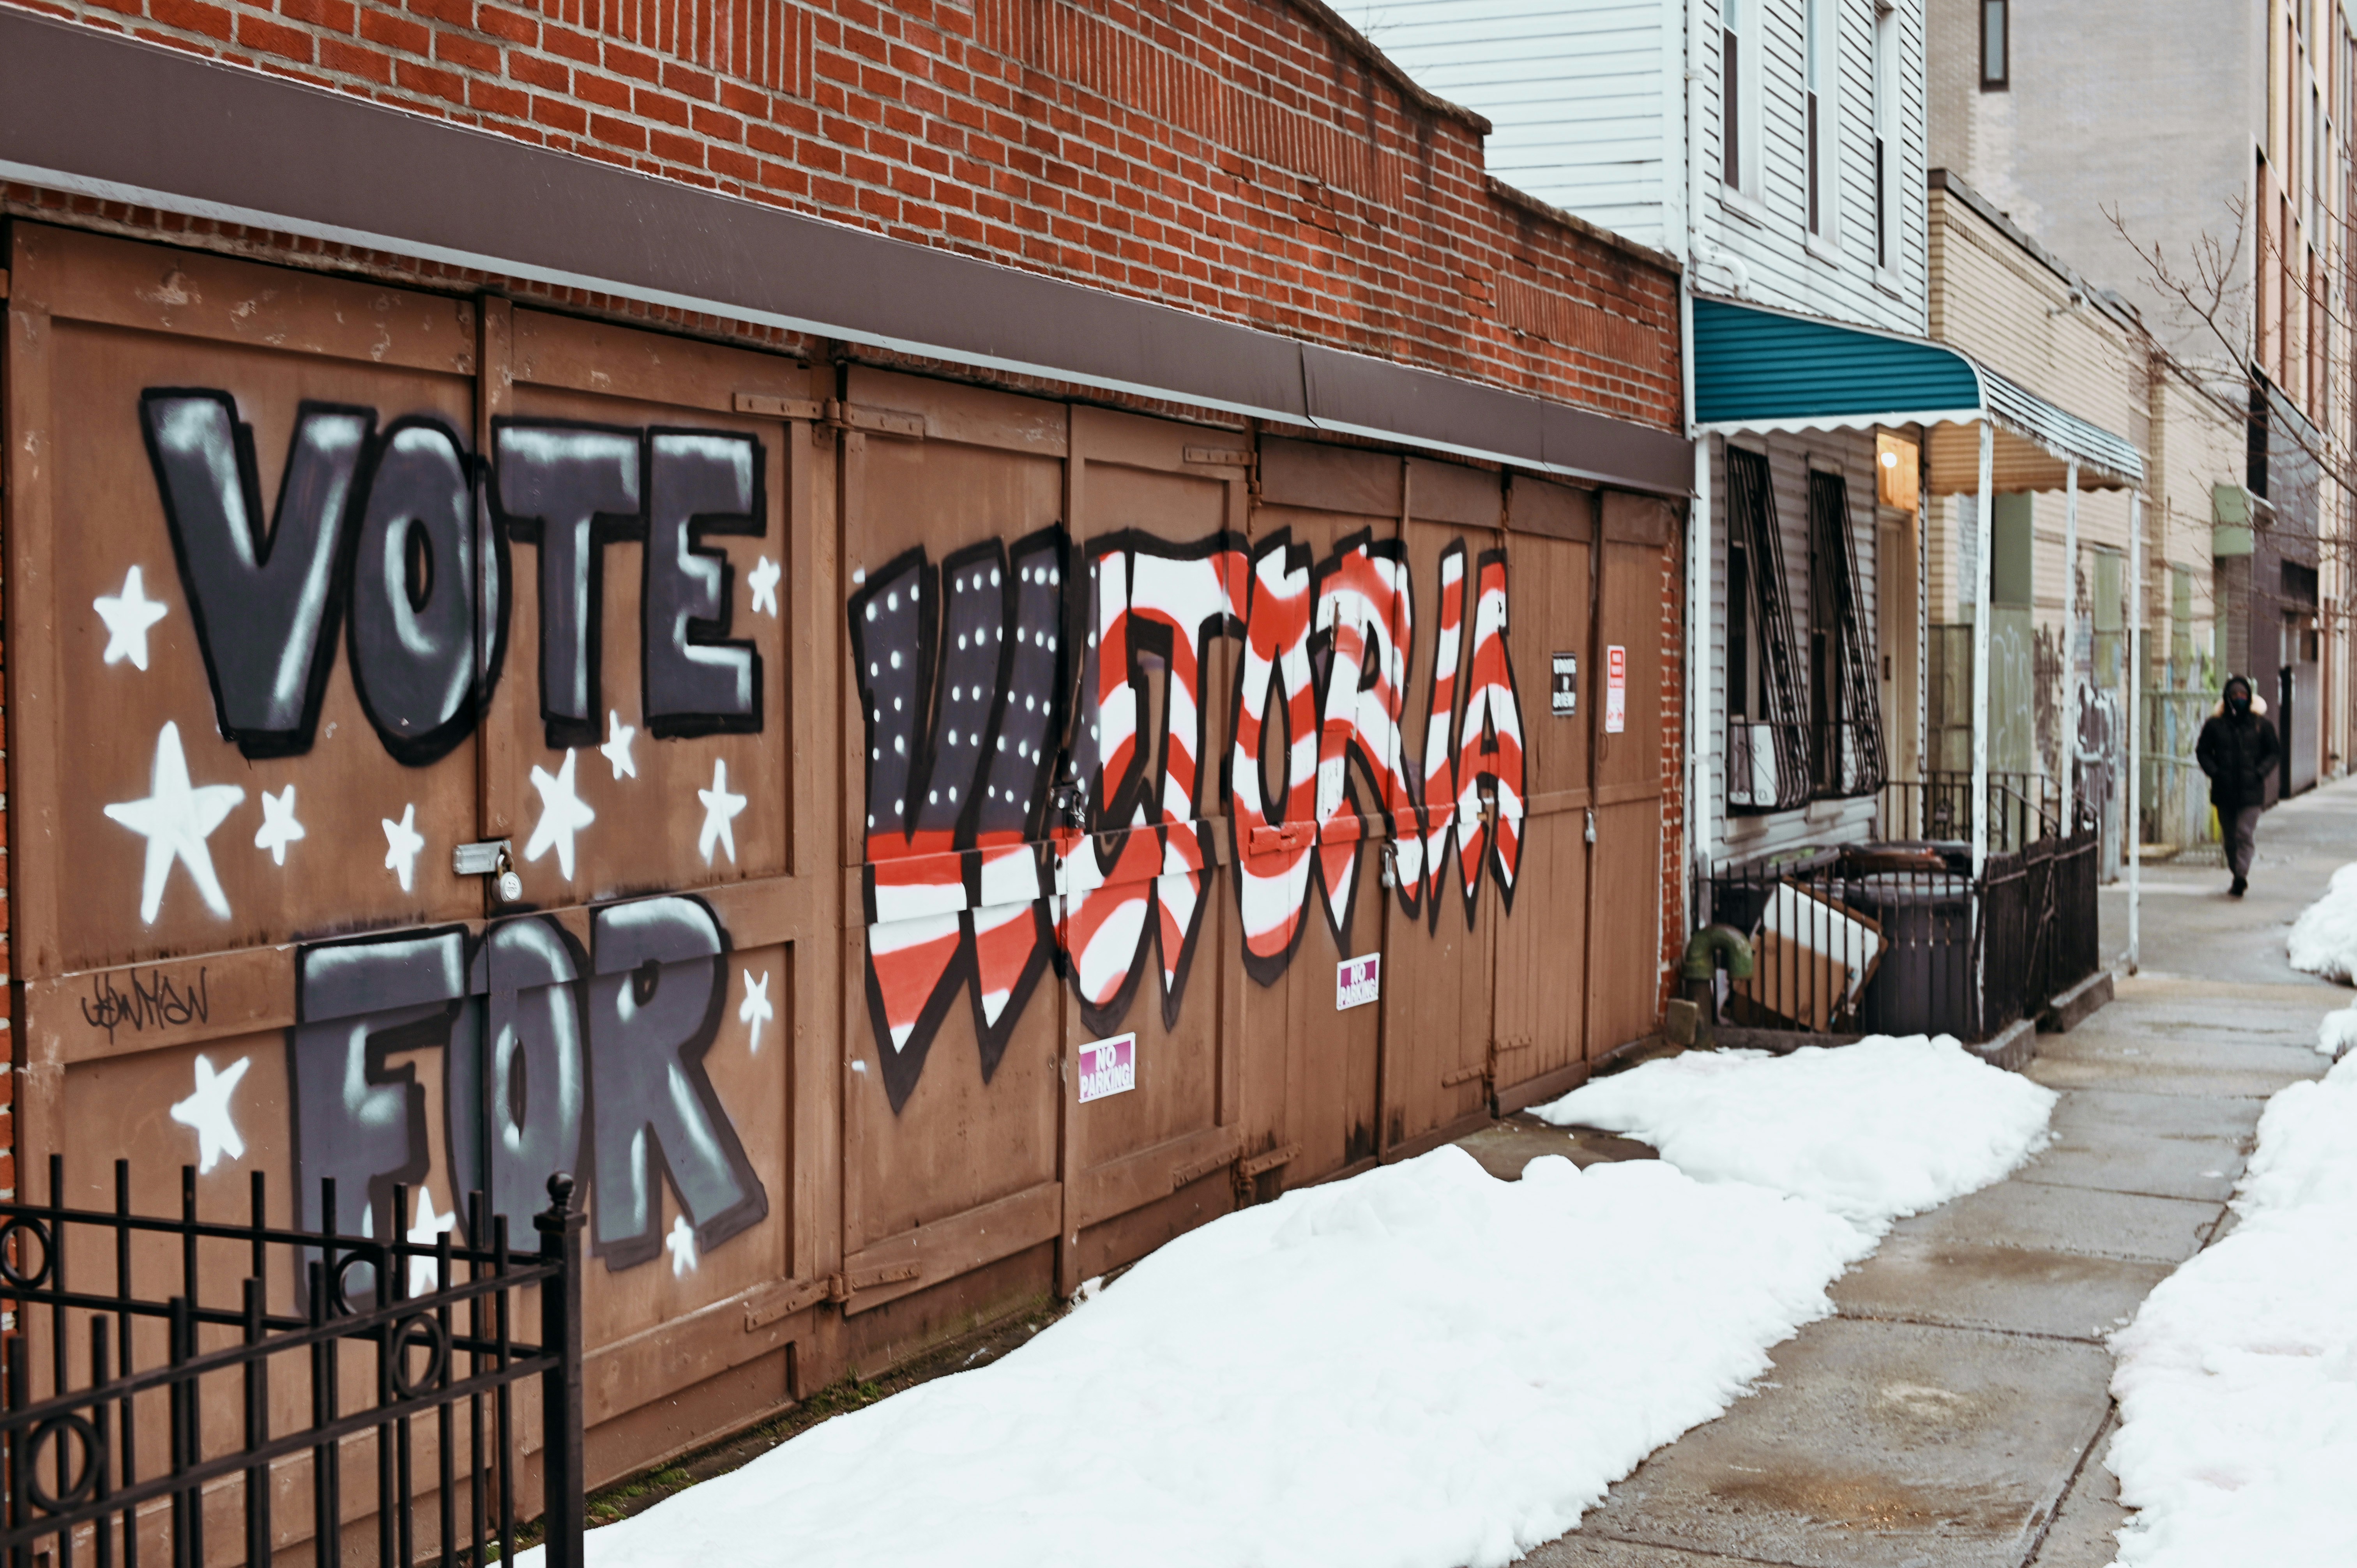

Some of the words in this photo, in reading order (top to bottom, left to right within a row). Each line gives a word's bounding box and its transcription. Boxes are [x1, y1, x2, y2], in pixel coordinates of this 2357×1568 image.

[140, 386, 766, 766] VOTE
[1095, 1044, 1117, 1071] NO
[1351, 962, 1366, 984] NO
[286, 893, 768, 1318] FOR
